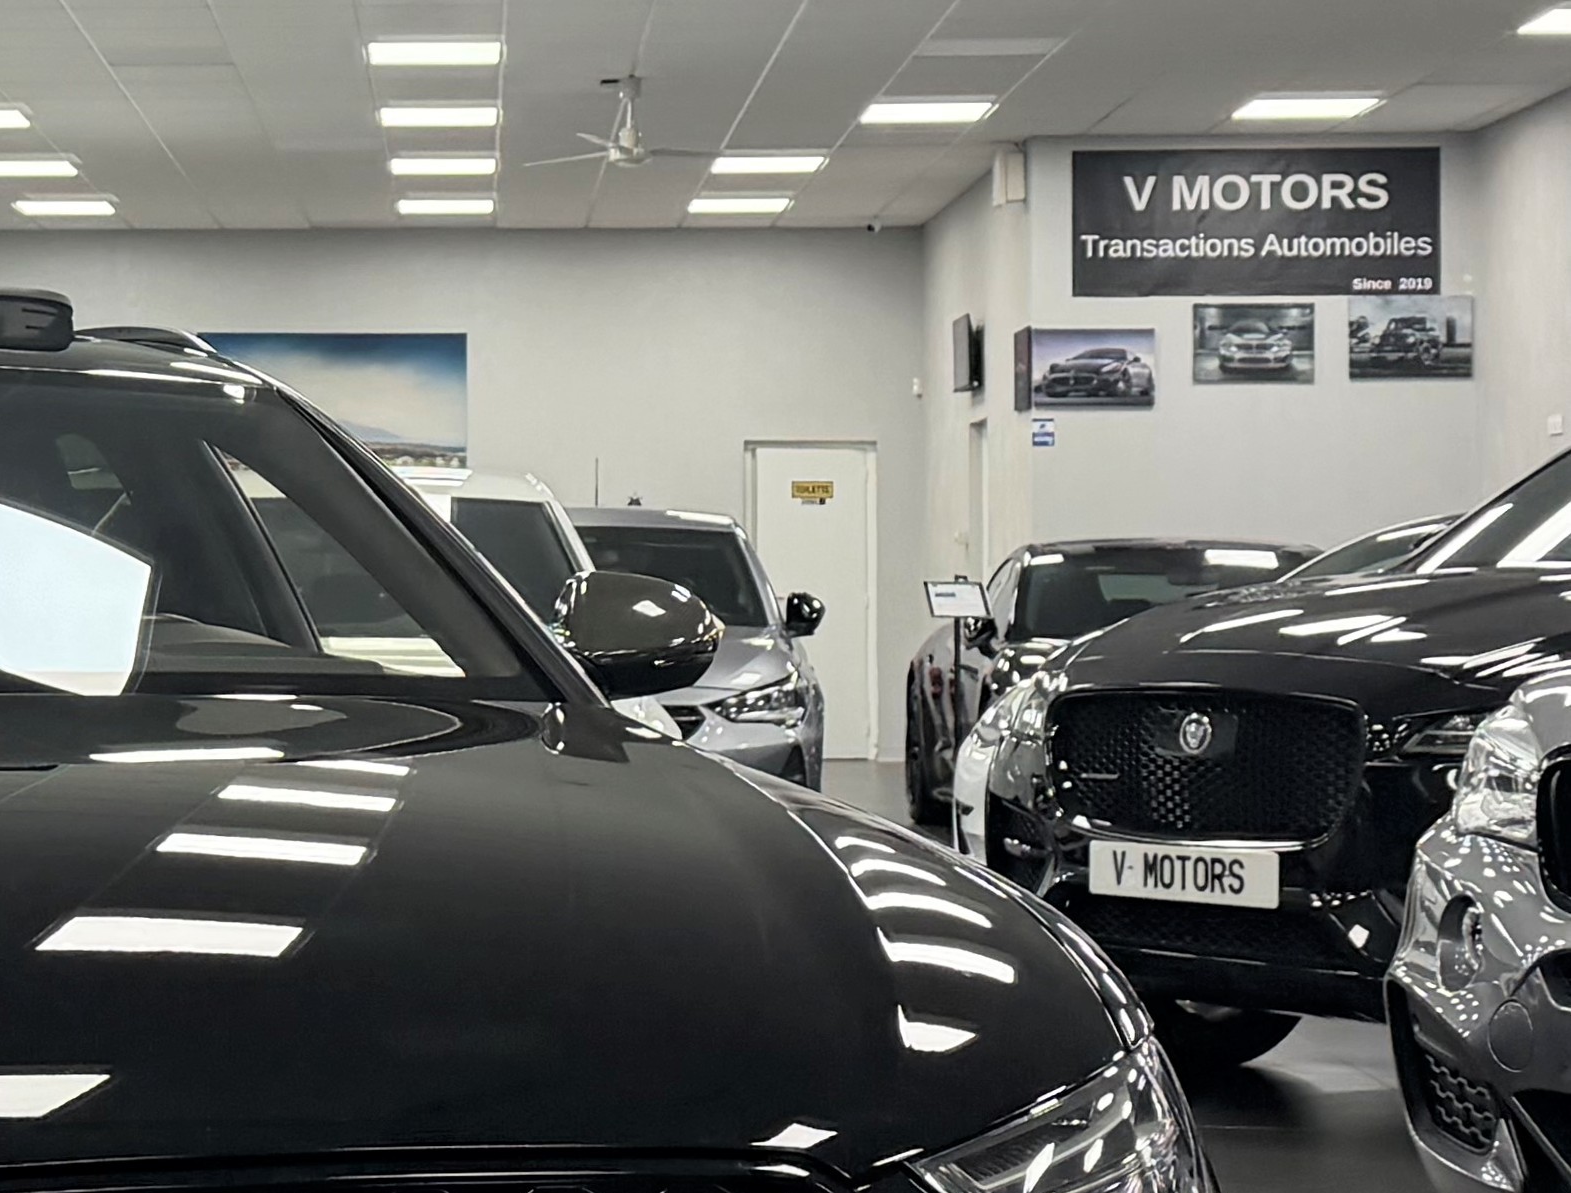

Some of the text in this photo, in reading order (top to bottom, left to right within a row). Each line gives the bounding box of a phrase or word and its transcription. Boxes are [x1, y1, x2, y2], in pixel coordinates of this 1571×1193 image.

[1122, 172, 1390, 212] V MOTORS
[1080, 231, 1433, 259] Transactions Automobiles
[1352, 276, 1433, 291] Since 2019
[1112, 850, 1245, 895] V MOTORS
